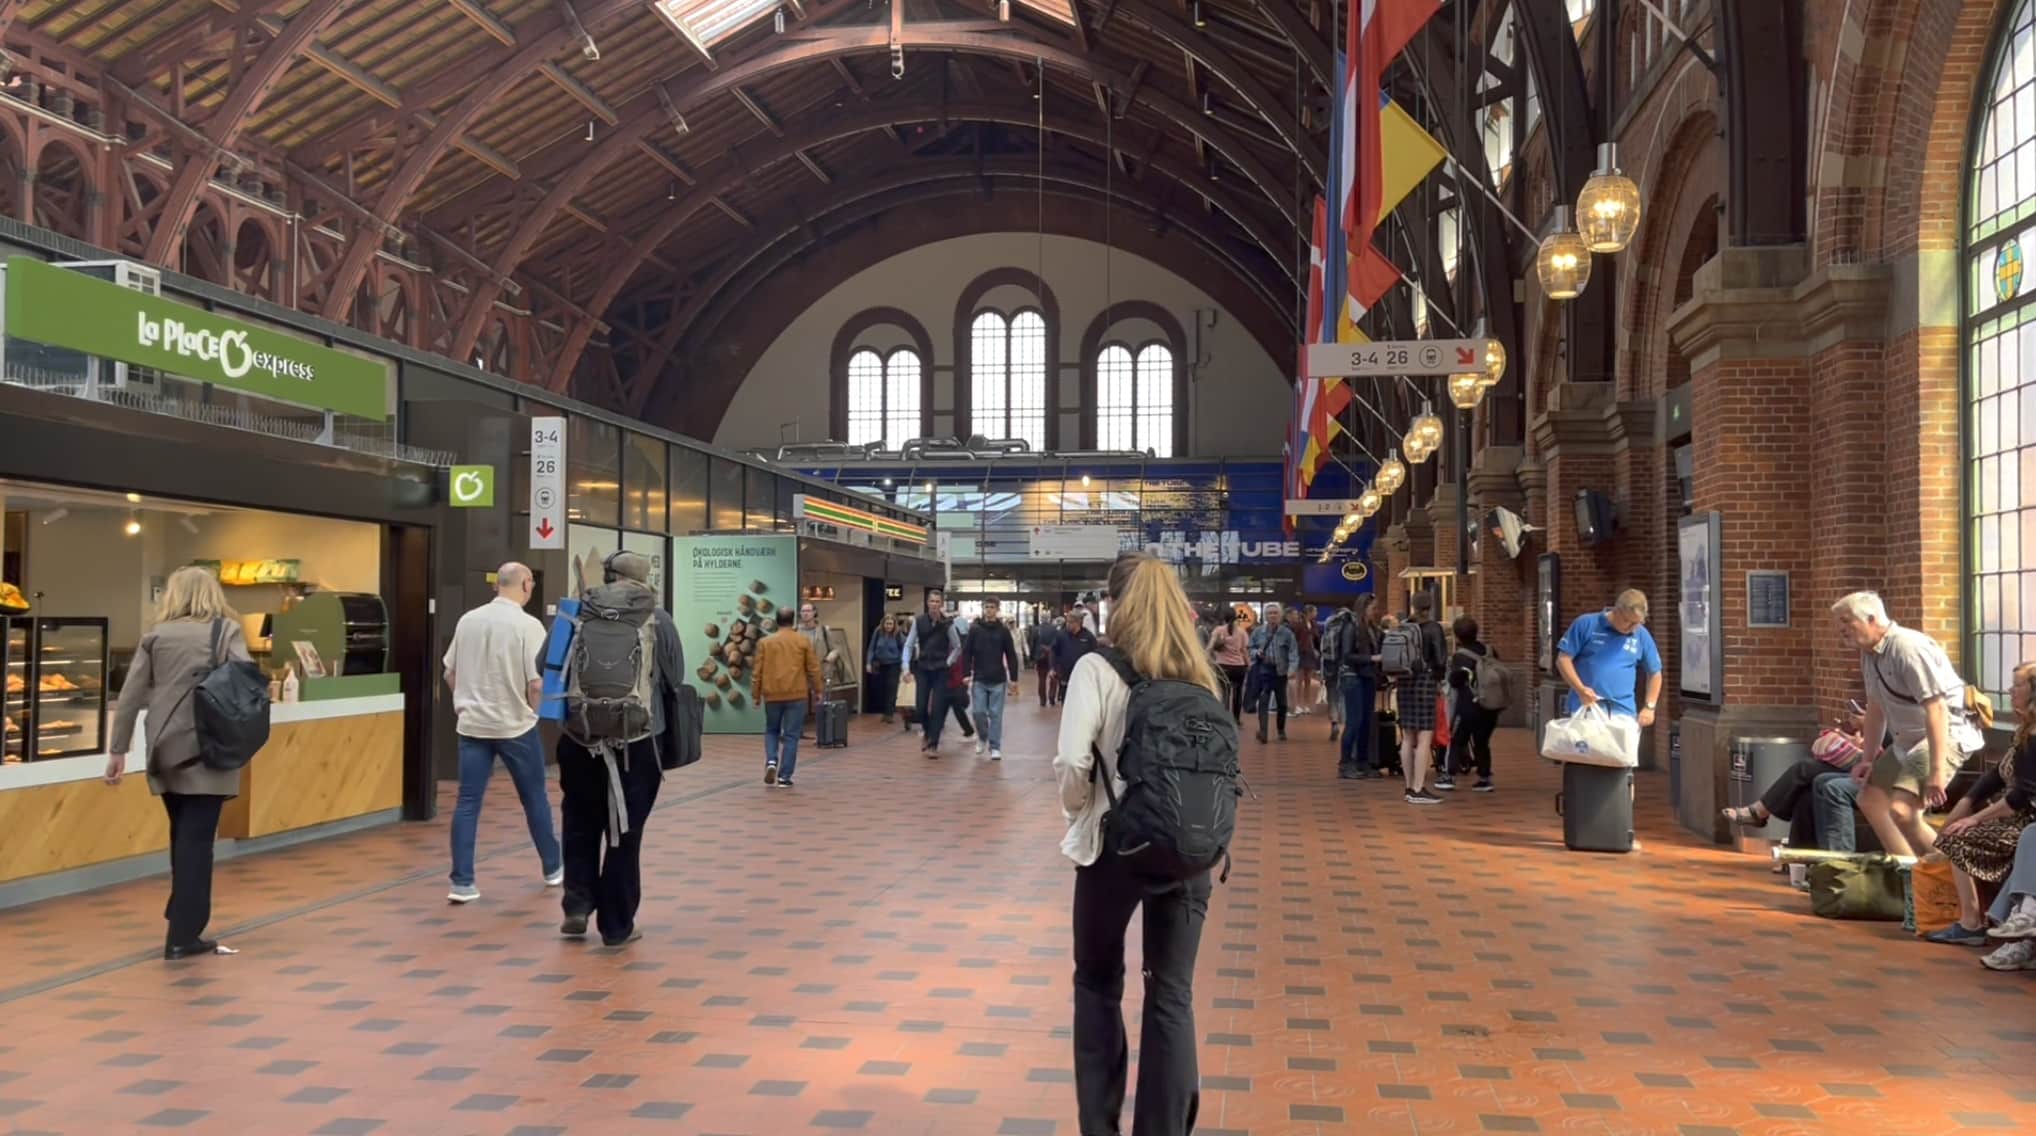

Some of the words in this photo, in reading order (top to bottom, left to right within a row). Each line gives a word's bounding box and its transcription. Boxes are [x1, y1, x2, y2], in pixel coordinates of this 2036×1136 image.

[138, 311, 160, 346] La
[252, 350, 315, 381] express
[1351, 351, 1378, 366] 3-4
[1386, 350, 1408, 365] 26
[535, 430, 558, 444] 3-4
[536, 460, 556, 474] 26
[1221, 542, 1299, 557] TUBE
[692, 557, 703, 569] PÅ
